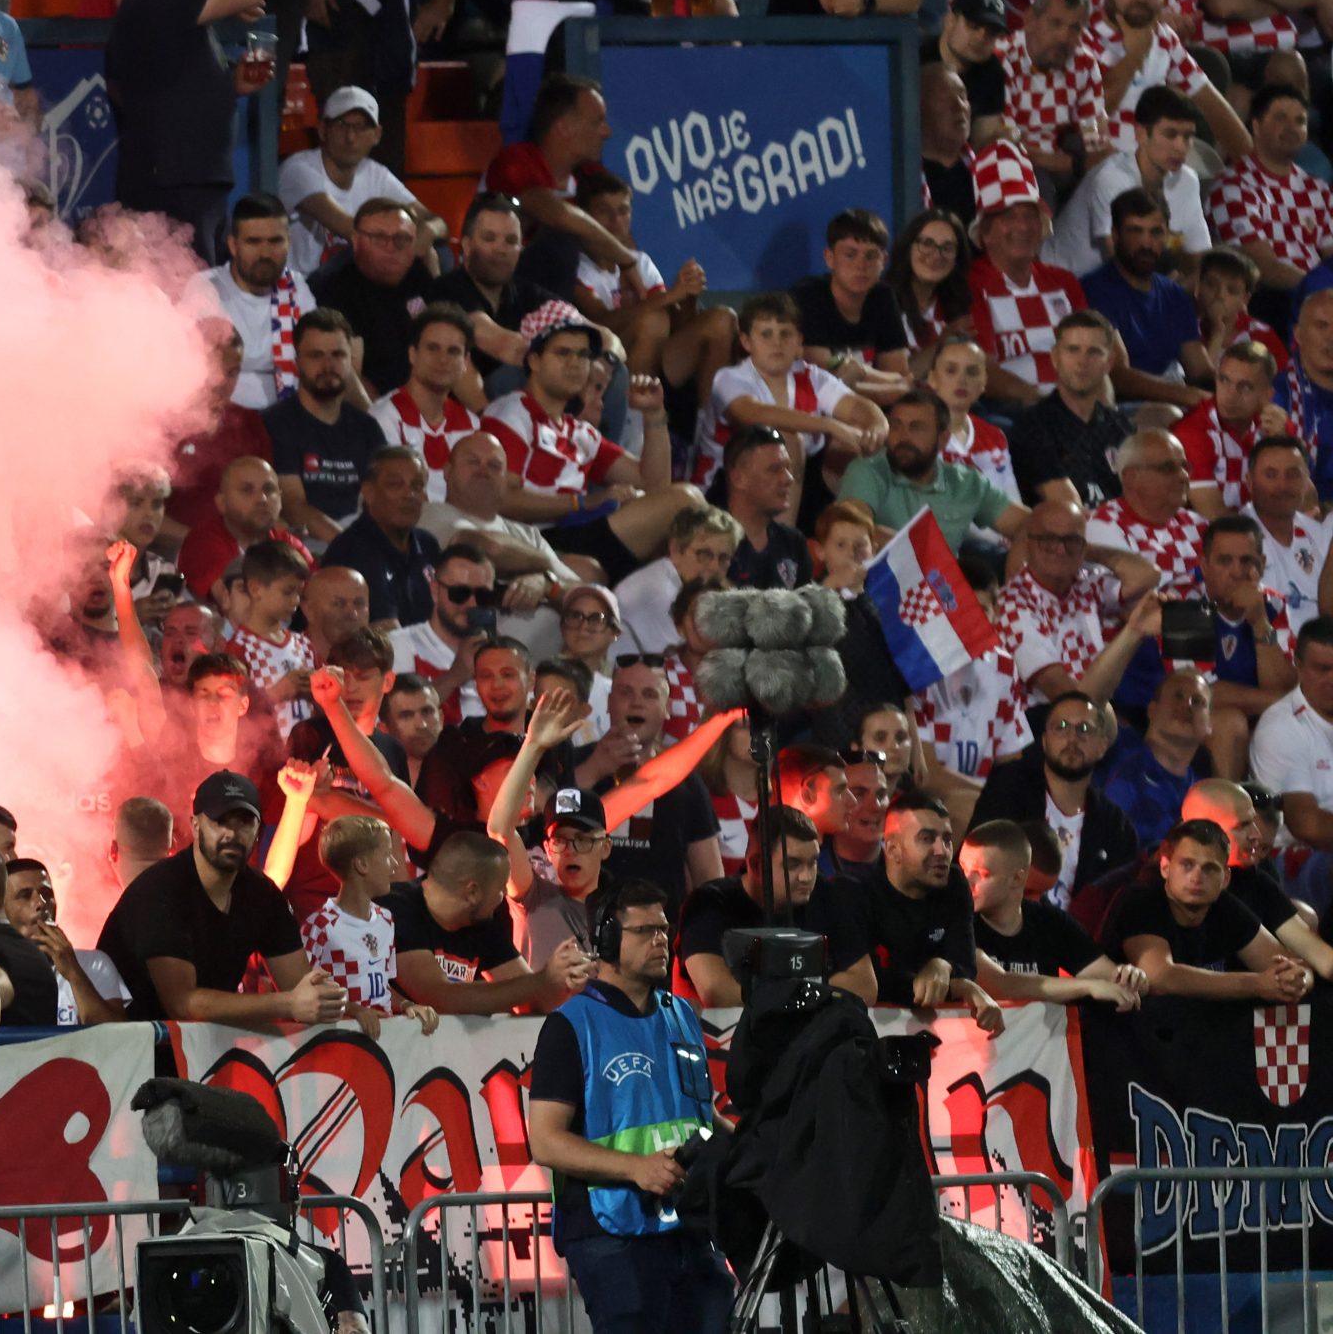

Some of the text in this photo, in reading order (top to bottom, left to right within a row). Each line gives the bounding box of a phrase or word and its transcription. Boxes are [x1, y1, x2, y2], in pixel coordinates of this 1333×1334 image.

[624, 109, 751, 194] OVO JE
[671, 108, 868, 229] NAŠ GRAD!
[790, 955, 803, 971] 15
[367, 972, 386, 999] 10
[605, 1056, 653, 1084] UEFA
[237, 1182, 247, 1198] 3
